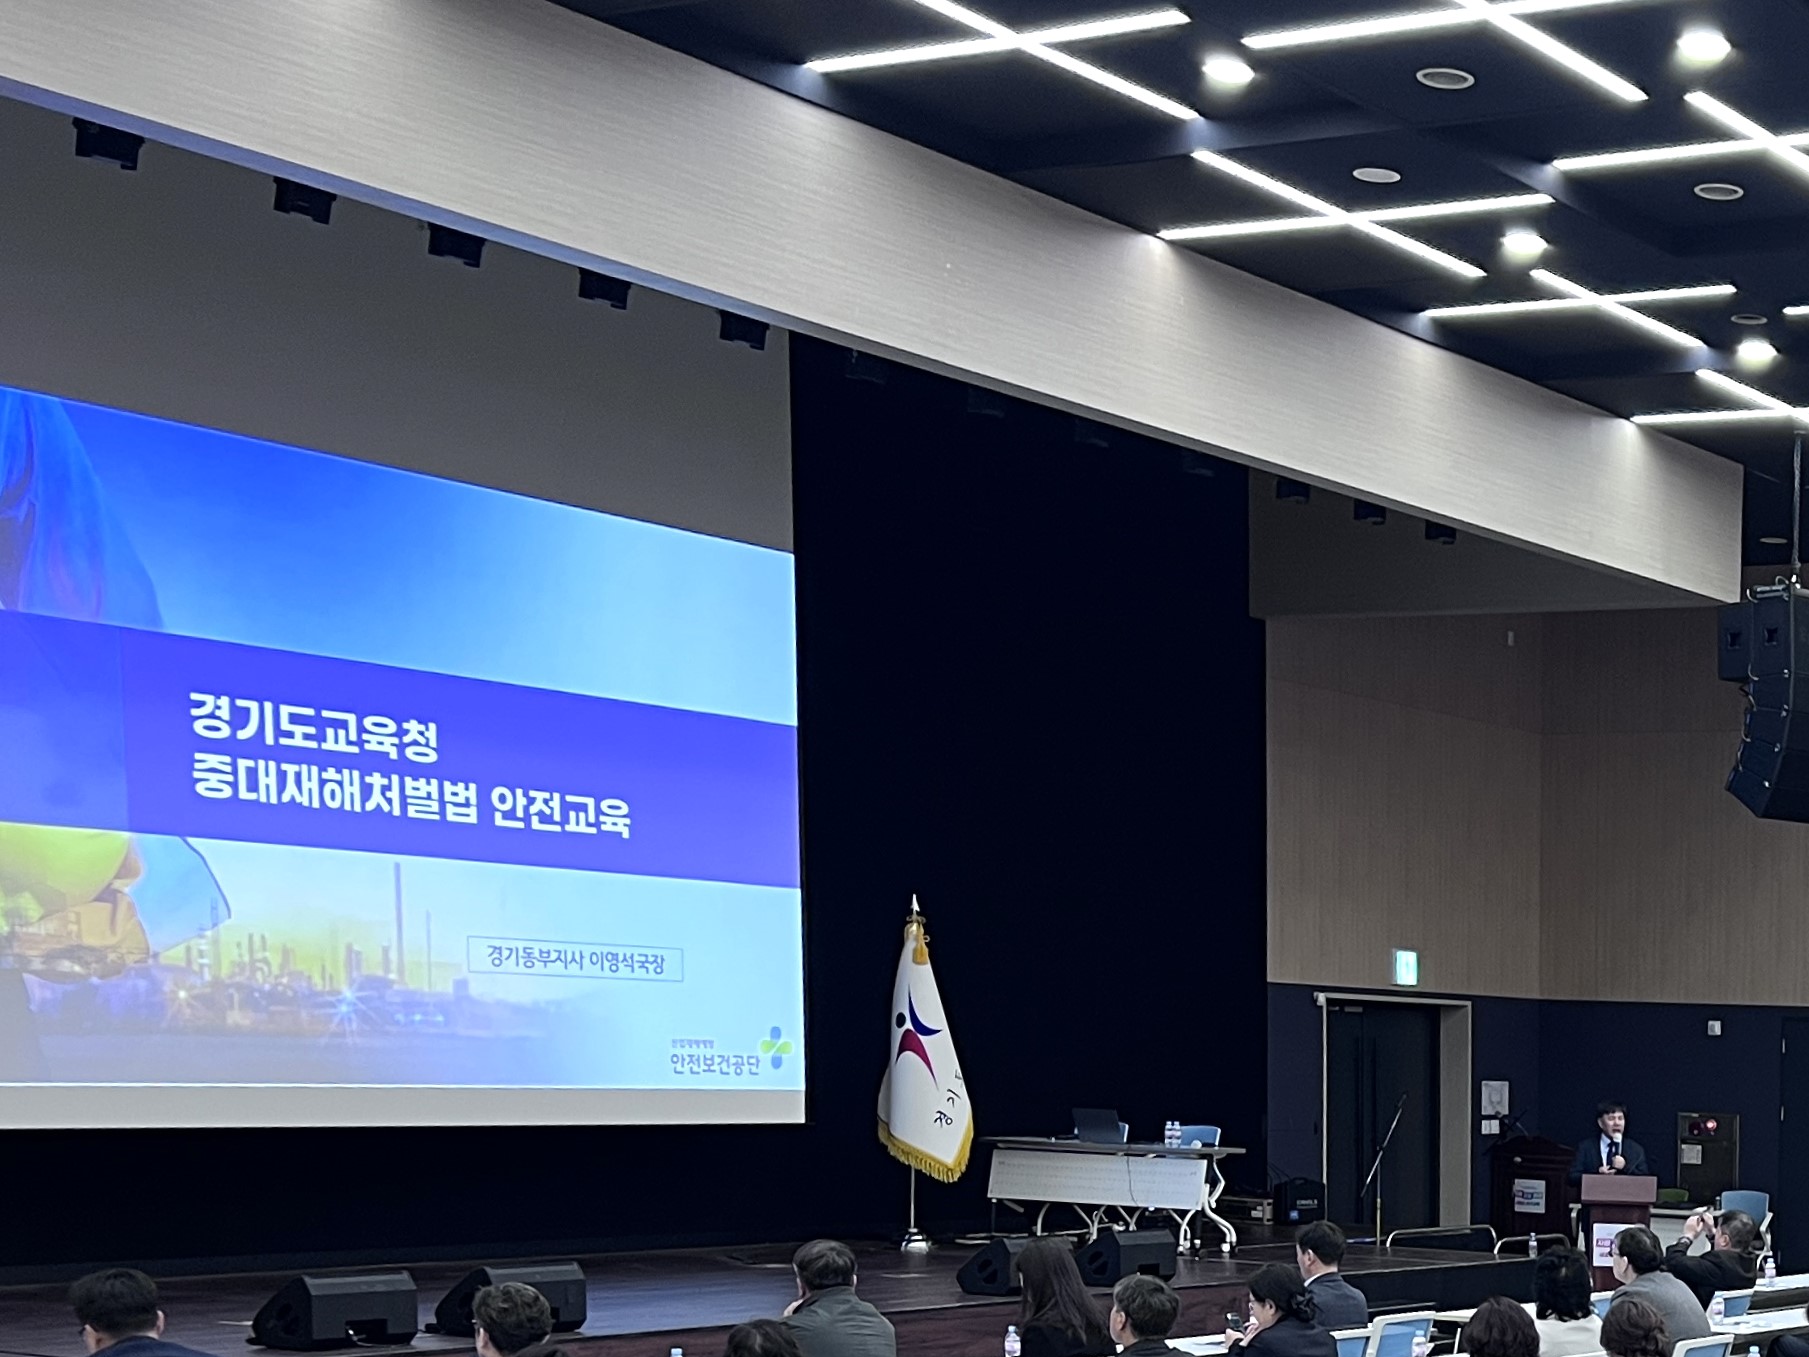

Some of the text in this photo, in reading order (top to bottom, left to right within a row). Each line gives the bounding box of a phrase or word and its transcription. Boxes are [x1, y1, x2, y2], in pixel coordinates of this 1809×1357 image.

[189, 691, 439, 764] 경기도교육청
[192, 752, 632, 840] 중대재해처벌법 안전교육
[486, 944, 667, 976] 경기동부지사 이영석국장
[670, 1053, 761, 1076] 안전보건공단
